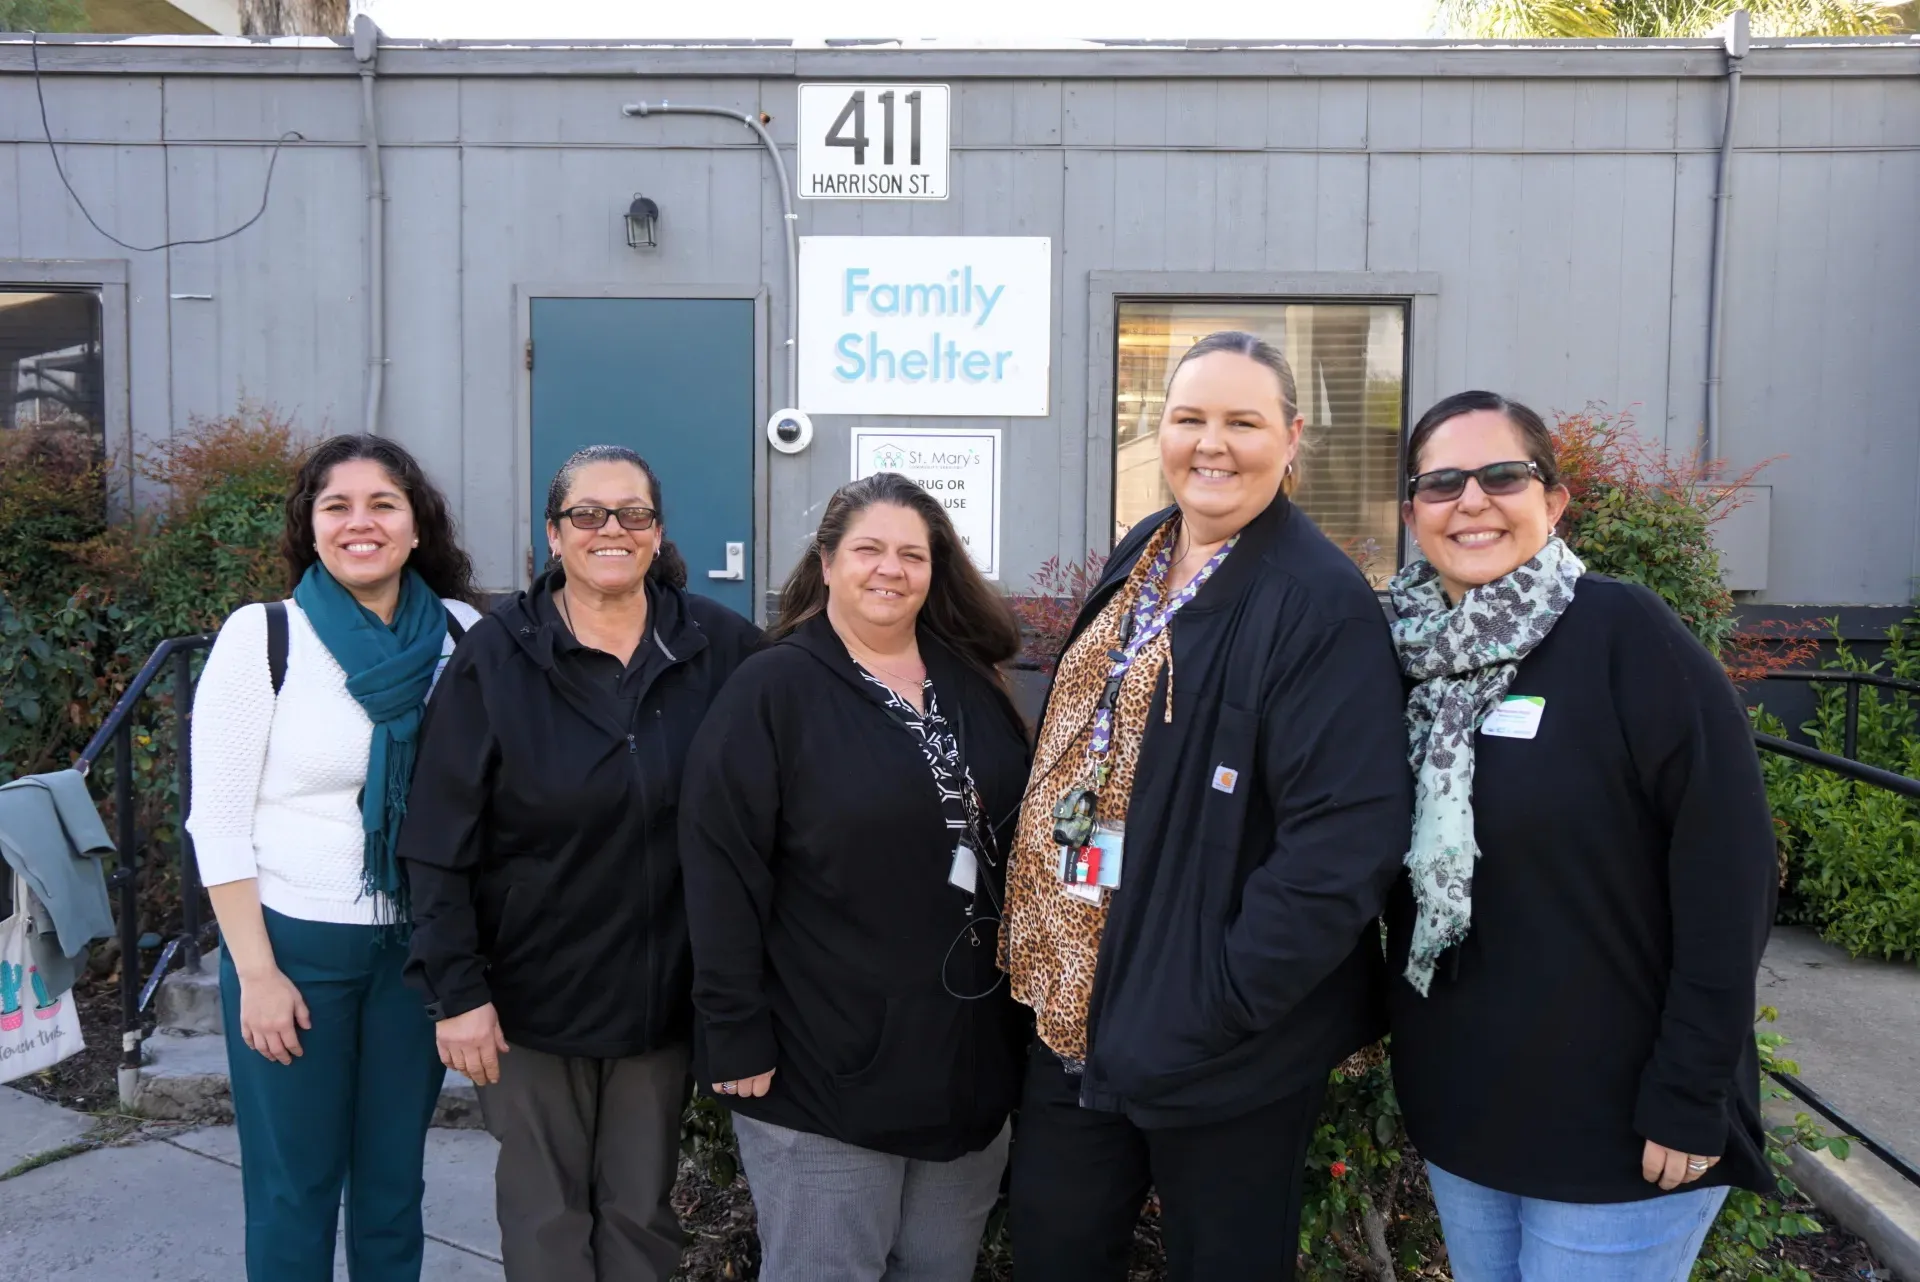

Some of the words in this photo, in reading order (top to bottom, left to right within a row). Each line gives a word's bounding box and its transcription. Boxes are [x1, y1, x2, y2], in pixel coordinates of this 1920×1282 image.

[825, 90, 921, 165] 411
[812, 173, 902, 194] HARRISON
[909, 173, 934, 194] ST.
[843, 265, 1006, 328] Family
[834, 331, 1013, 382] Shelter
[909, 450, 927, 464] St.
[931, 448, 980, 467] Mary's
[947, 479, 965, 490] OR
[944, 498, 967, 509] USE
